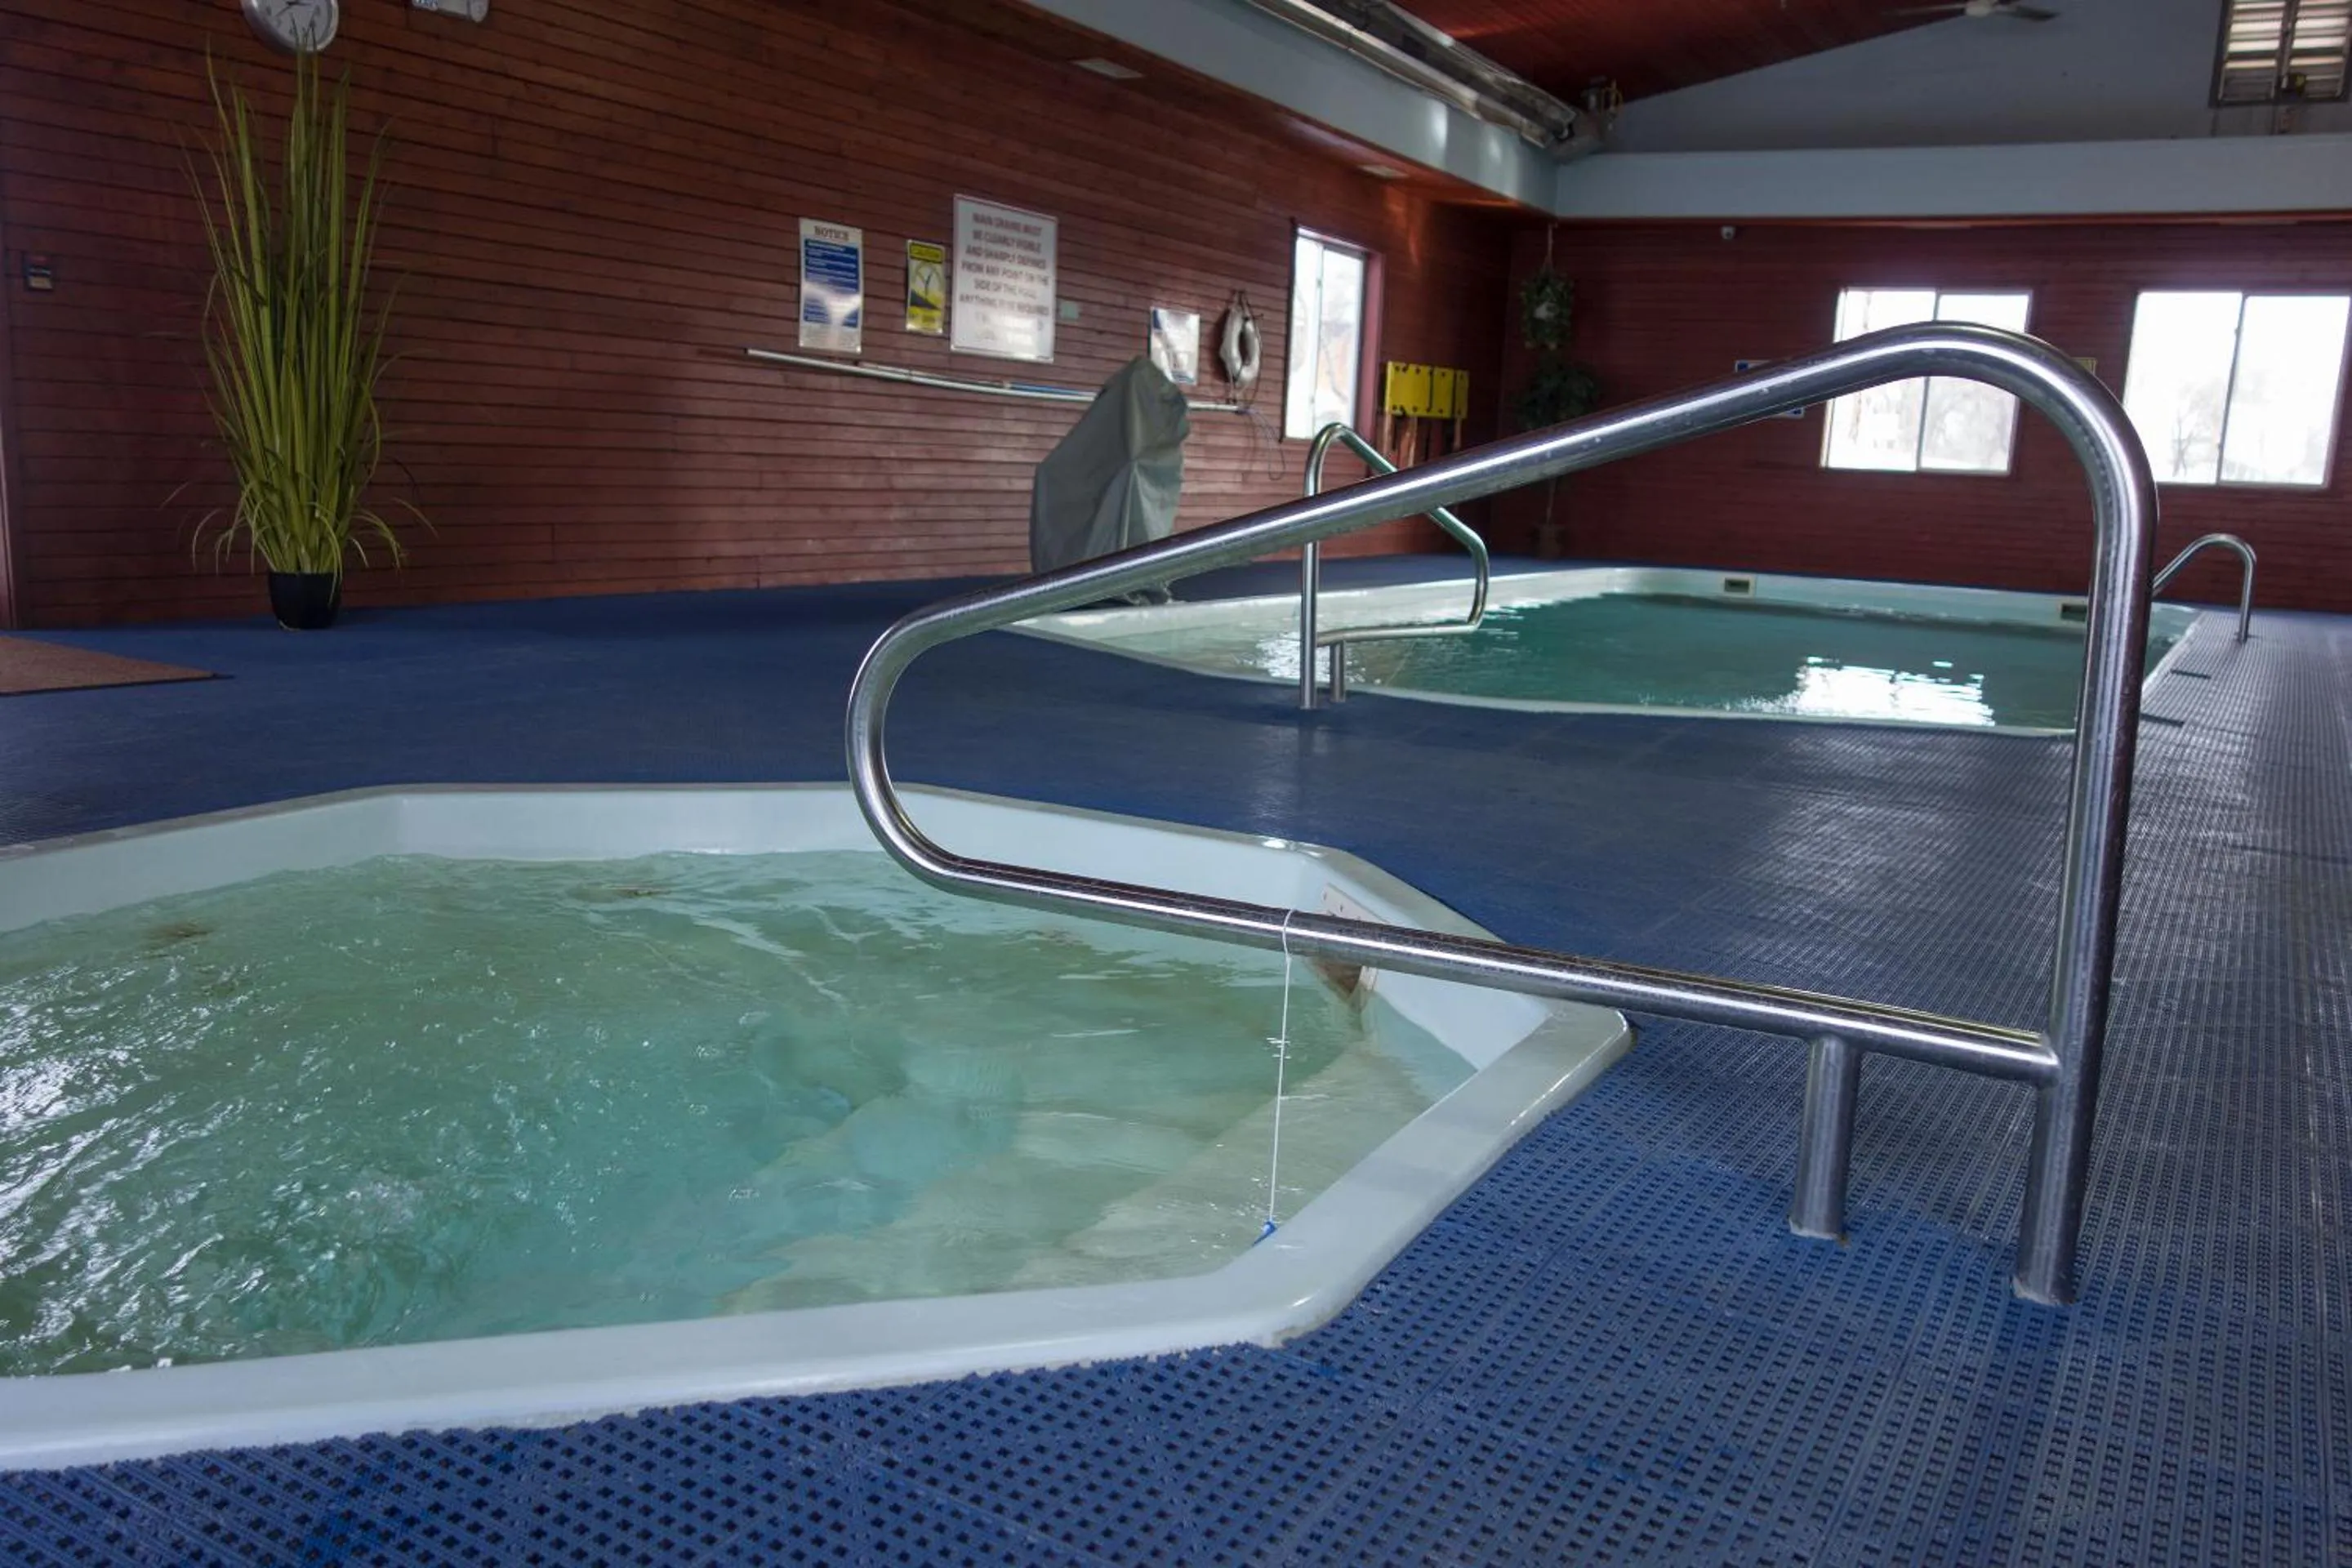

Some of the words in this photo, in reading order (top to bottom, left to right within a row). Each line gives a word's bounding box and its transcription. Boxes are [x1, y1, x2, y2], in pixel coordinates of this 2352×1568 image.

[813, 225, 849, 240] NOTICE
[966, 244, 982, 256] AND
[961, 259, 984, 273] FROM
[1001, 267, 1022, 279] POINT
[973, 278, 990, 291] SIDE
[1003, 283, 1017, 296] THE
